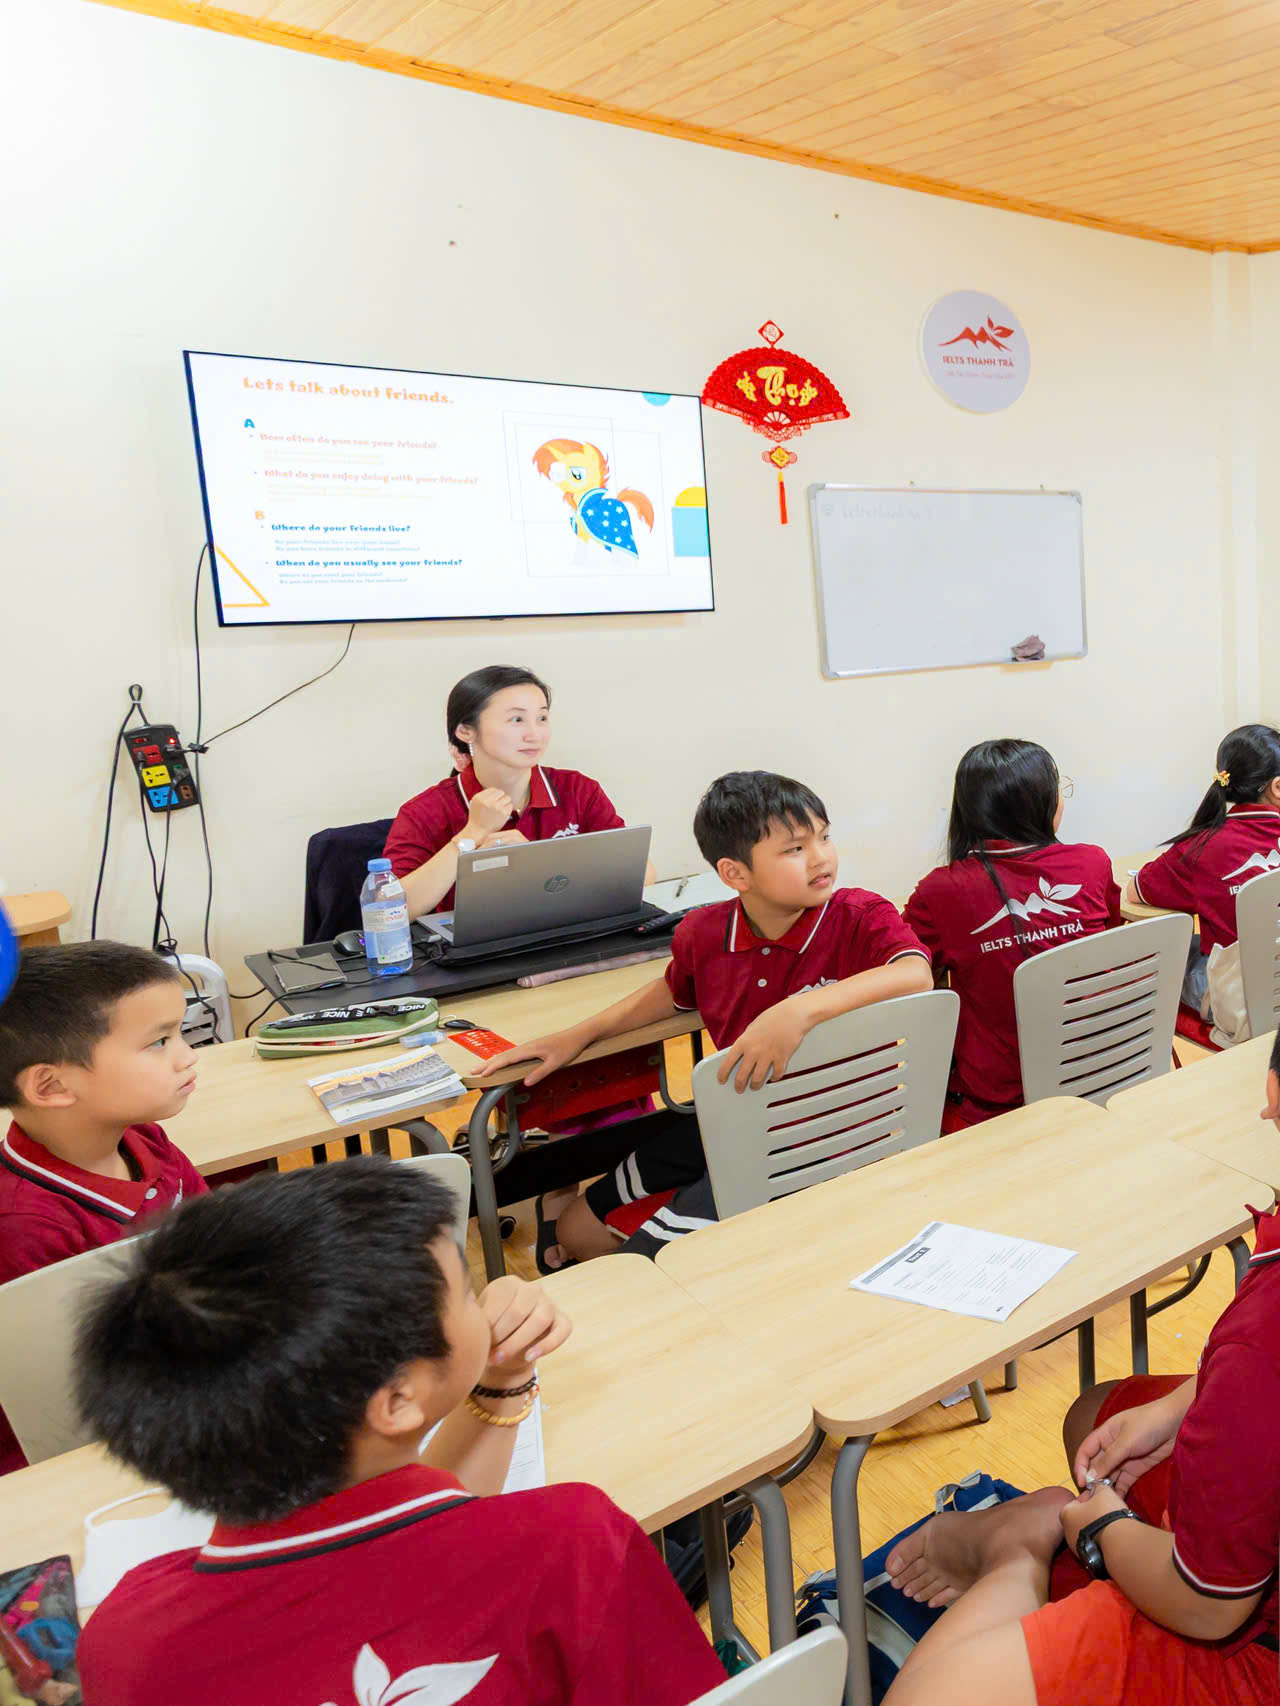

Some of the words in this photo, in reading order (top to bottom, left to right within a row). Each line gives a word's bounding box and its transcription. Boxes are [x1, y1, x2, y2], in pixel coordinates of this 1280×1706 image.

[943, 355, 964, 365] IELTS
[967, 357, 996, 367] THANH
[242, 377, 285, 392] Lets
[289, 379, 325, 395] talk
[329, 383, 380, 399] about
[243, 417, 256, 429] A
[317, 435, 330, 445] do
[331, 437, 351, 447] you
[295, 470, 308, 479] do
[310, 471, 329, 481] you
[255, 509, 265, 521] B
[271, 523, 306, 532] Where
[308, 523, 321, 532] do
[323, 525, 347, 534] your
[349, 523, 387, 533] friends
[388, 524, 412, 533] live?
[275, 559, 306, 567] When
[308, 559, 321, 567] do
[323, 561, 342, 569] you
[343, 559, 379, 568] usually
[399, 561, 422, 569] your
[423, 558, 463, 567] friends?
[980, 936, 1013, 953] IELTS
[1014, 926, 1058, 945] THANH
[1060, 919, 1084, 935] TRÀ
[321, 1010, 351, 1019] NICE
